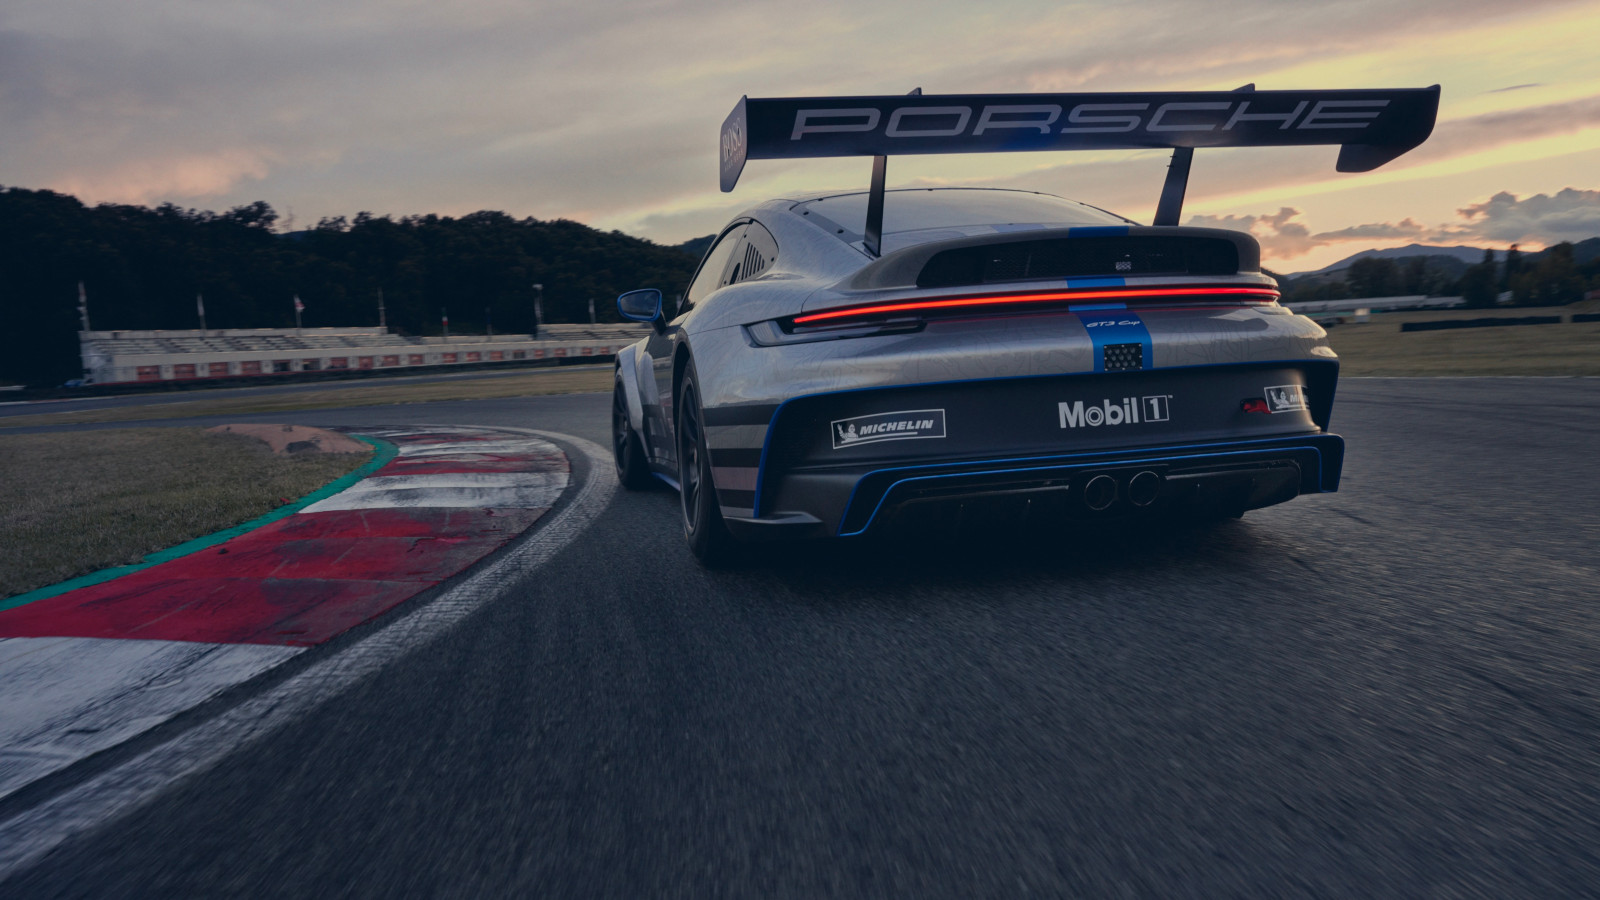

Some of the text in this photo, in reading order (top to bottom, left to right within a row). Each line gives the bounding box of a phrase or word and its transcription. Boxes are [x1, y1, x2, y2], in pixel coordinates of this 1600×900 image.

[790, 99, 1391, 141] PORSCHE
[722, 117, 743, 163] BOSS
[1086, 319, 1141, 328] GT3 Cup
[859, 419, 934, 436] MICHELIN
[1058, 396, 1139, 429] Mobil
